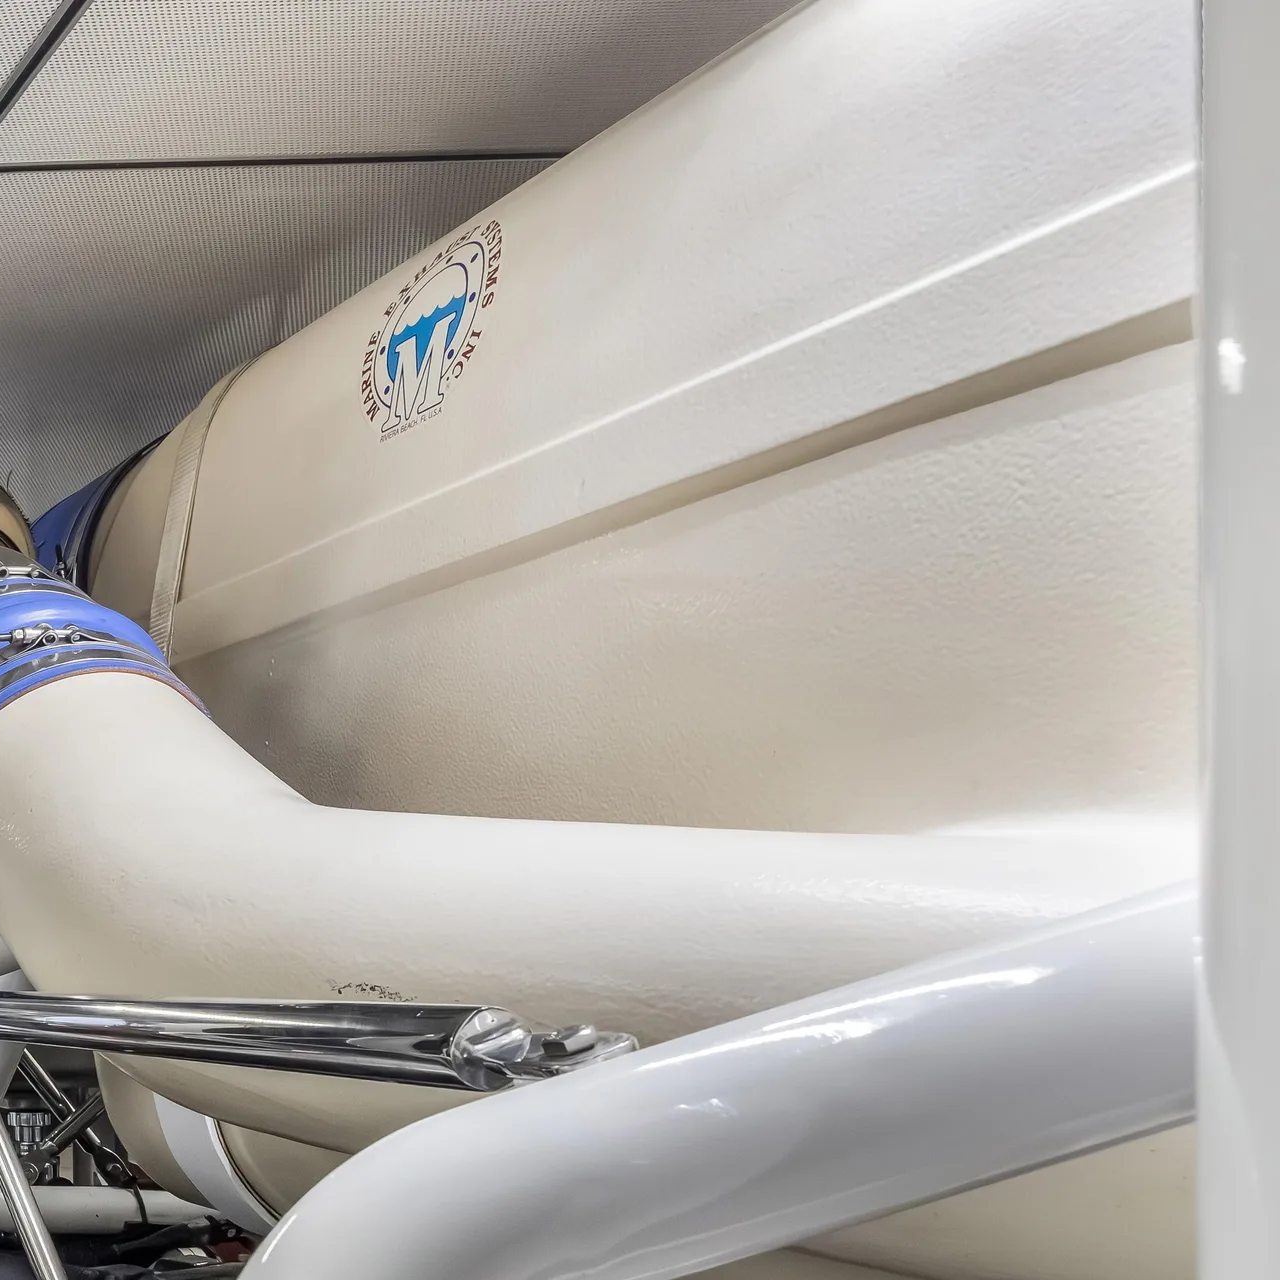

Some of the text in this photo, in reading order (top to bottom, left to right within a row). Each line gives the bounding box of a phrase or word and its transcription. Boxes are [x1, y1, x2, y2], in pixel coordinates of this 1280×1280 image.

[361, 330, 381, 423] MARINE
[384, 224, 481, 318] EXHAUST
[481, 219, 502, 309] SYSTEMS
